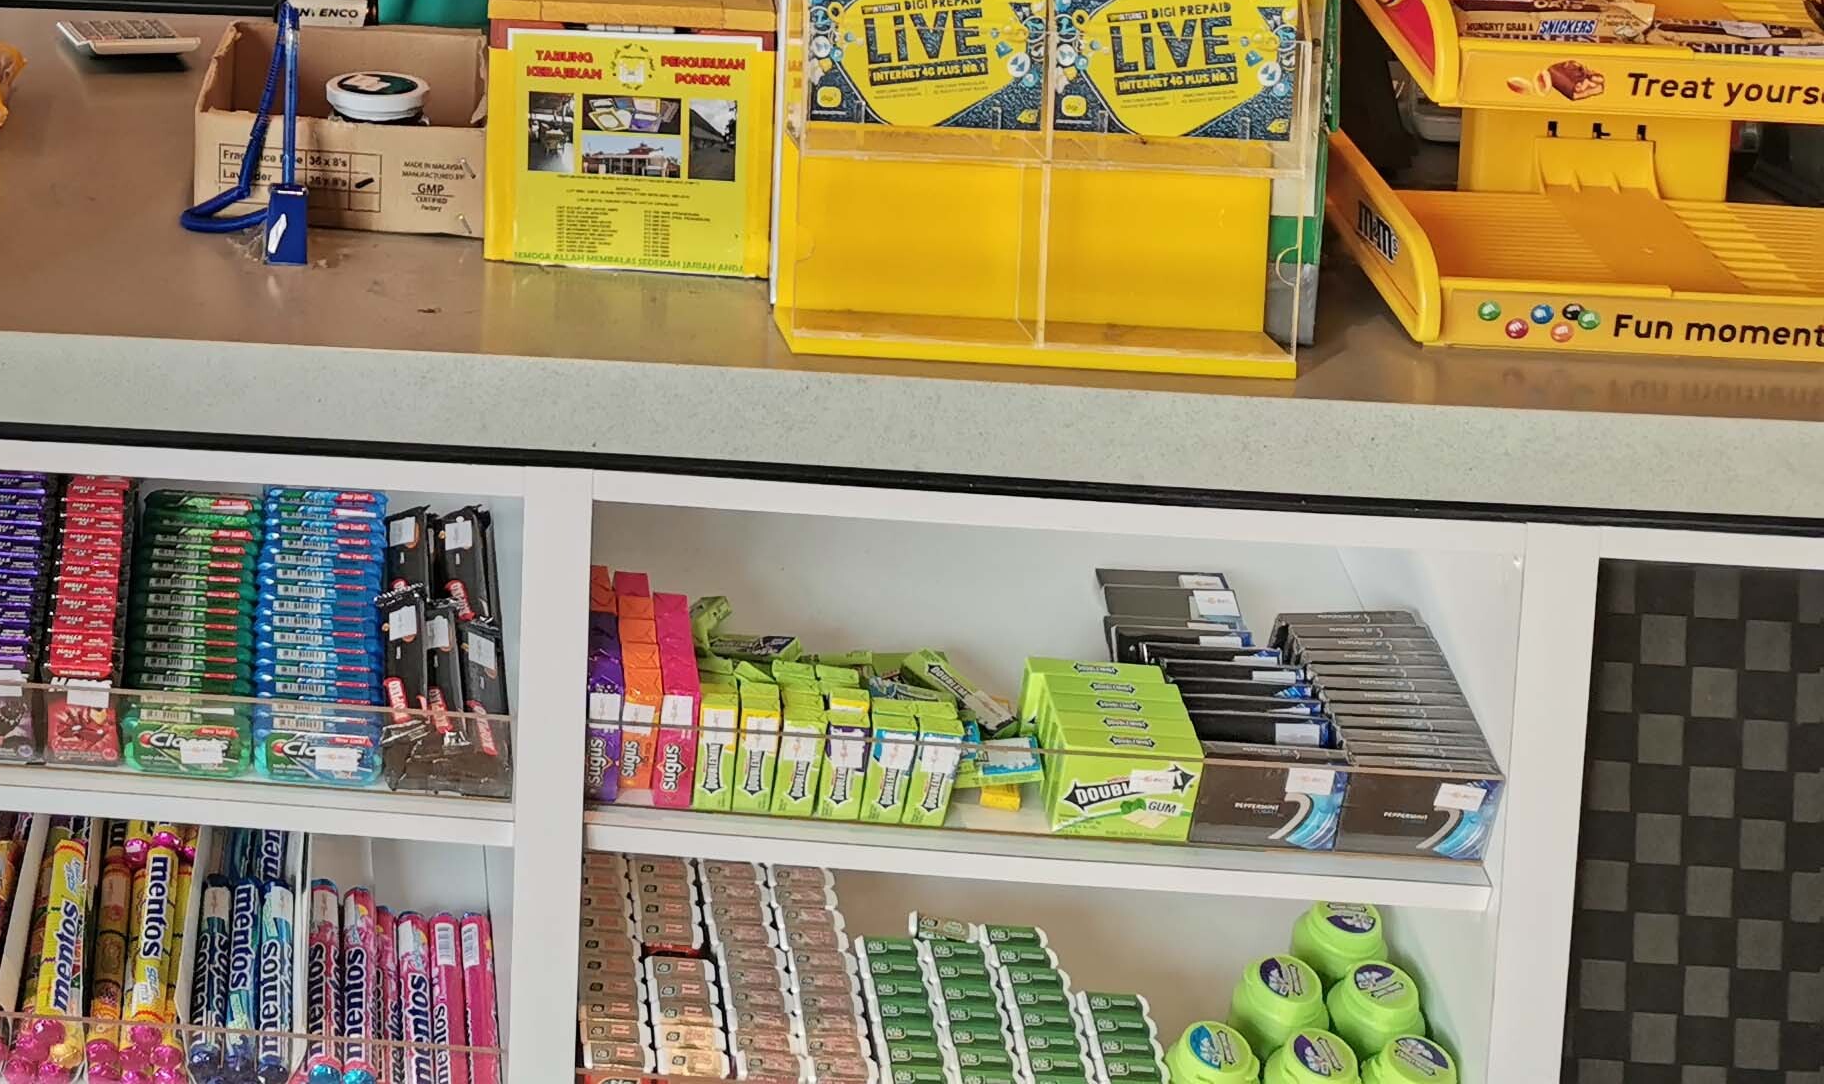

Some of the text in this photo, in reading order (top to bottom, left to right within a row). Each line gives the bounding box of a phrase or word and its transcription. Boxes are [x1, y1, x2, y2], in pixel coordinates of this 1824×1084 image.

[904, 0, 929, 11] DIGI
[1152, 7, 1175, 19] DIGI
[1180, 2, 1232, 15] PREPAID
[1466, 22, 1505, 33] HUNGRY?
[1506, 23, 1527, 33] GRAB
[1539, 19, 1597, 35] SNICKERS
[536, 49, 594, 64] TABUNG
[661, 55, 746, 70] PENGURUSAN
[527, 66, 603, 81] KEBAJIKAN
[675, 72, 731, 87] PONDOK
[873, 67, 921, 82] INTERNET
[935, 63, 961, 76] PLUS
[1119, 77, 1168, 91] INTERNET
[1185, 73, 1210, 85] PLUS
[1628, 72, 1714, 100] Treat
[417, 182, 445, 195] GMP
[553, 252, 584, 263] ALLAH
[586, 254, 636, 266] MEMBALAS
[638, 256, 680, 268] SEDEKAH
[1613, 313, 1673, 340] Fun
[588, 739, 607, 785] sugus
[622, 740, 640, 778] sugus
[662, 744, 681, 791] sugus
[1148, 801, 1177, 814] GUM
[141, 855, 171, 959] mentos
[230, 883, 254, 990] mentos
[54, 900, 79, 1013] mentos
